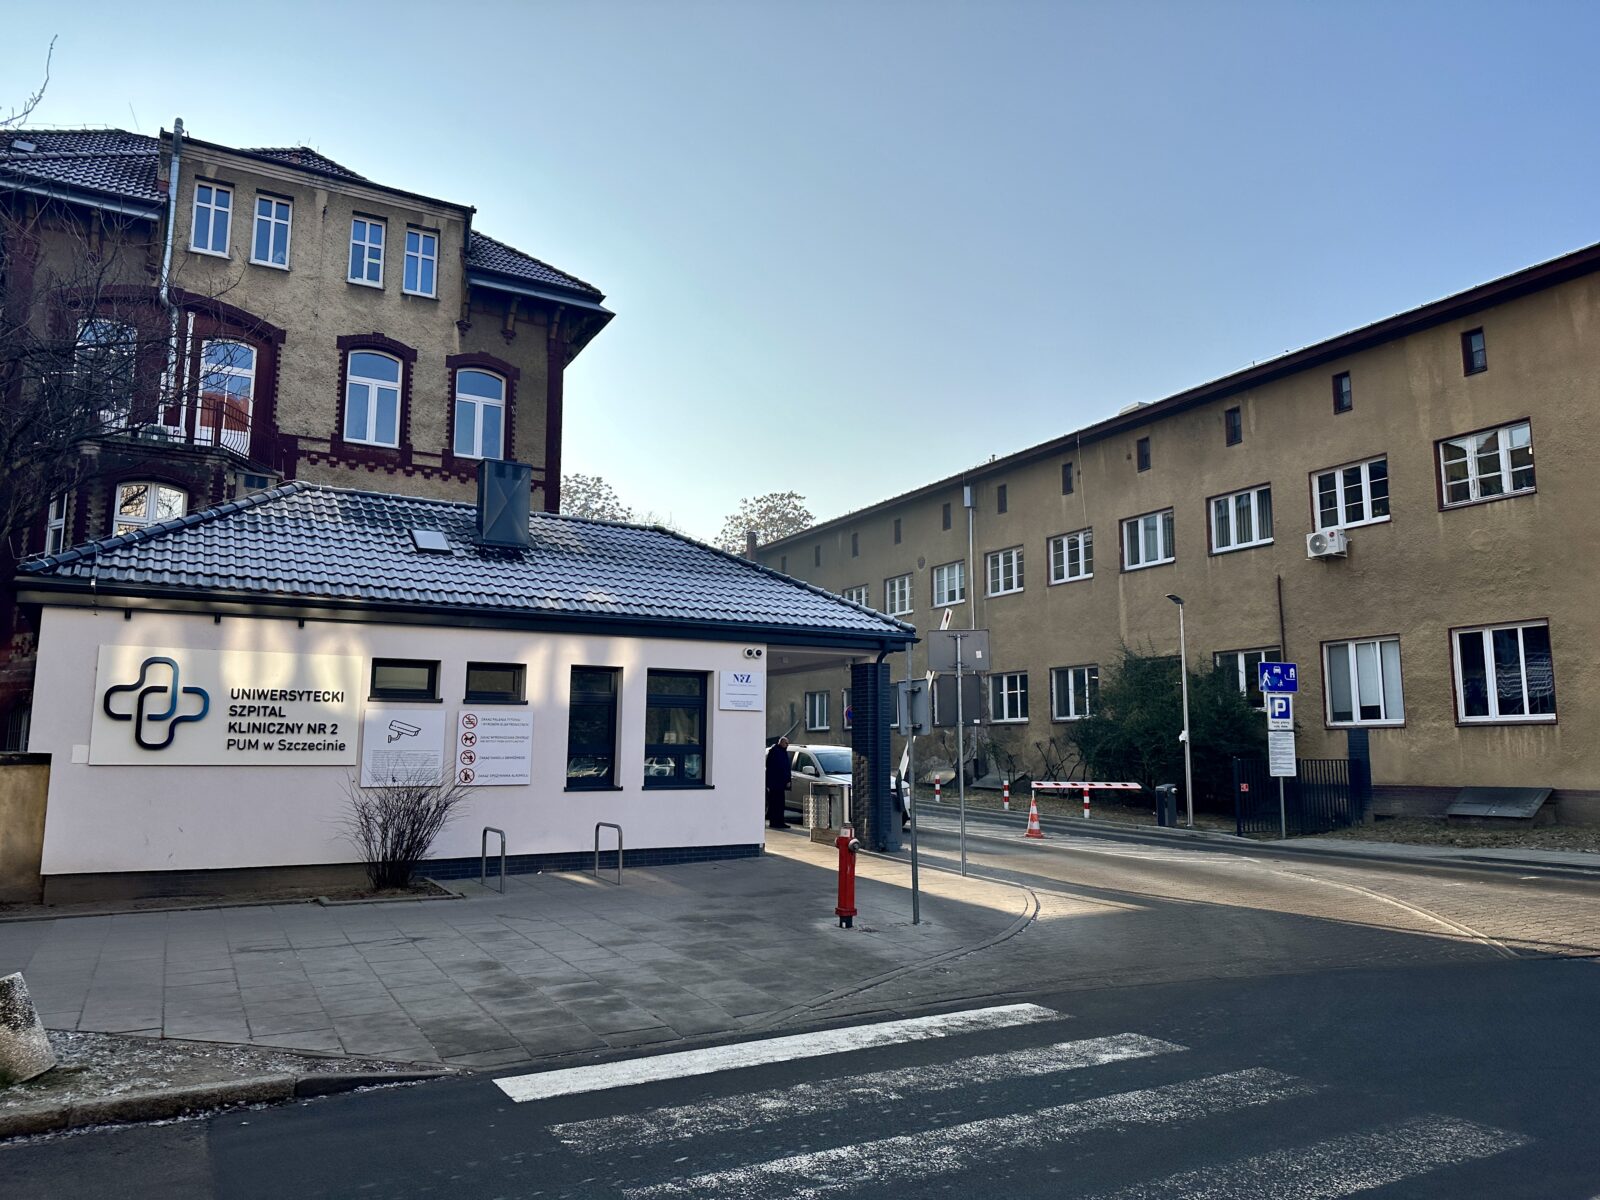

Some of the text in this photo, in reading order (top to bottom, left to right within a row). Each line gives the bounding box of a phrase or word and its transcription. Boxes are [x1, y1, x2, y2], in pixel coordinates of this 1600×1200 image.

[231, 688, 344, 702] UNIWERSYTECKI
[229, 705, 286, 717] SZPITAL
[1275, 699, 1286, 717] P
[228, 722, 338, 735] KLINICZNY NR 2
[227, 739, 346, 751] PUM w Szczecinie
